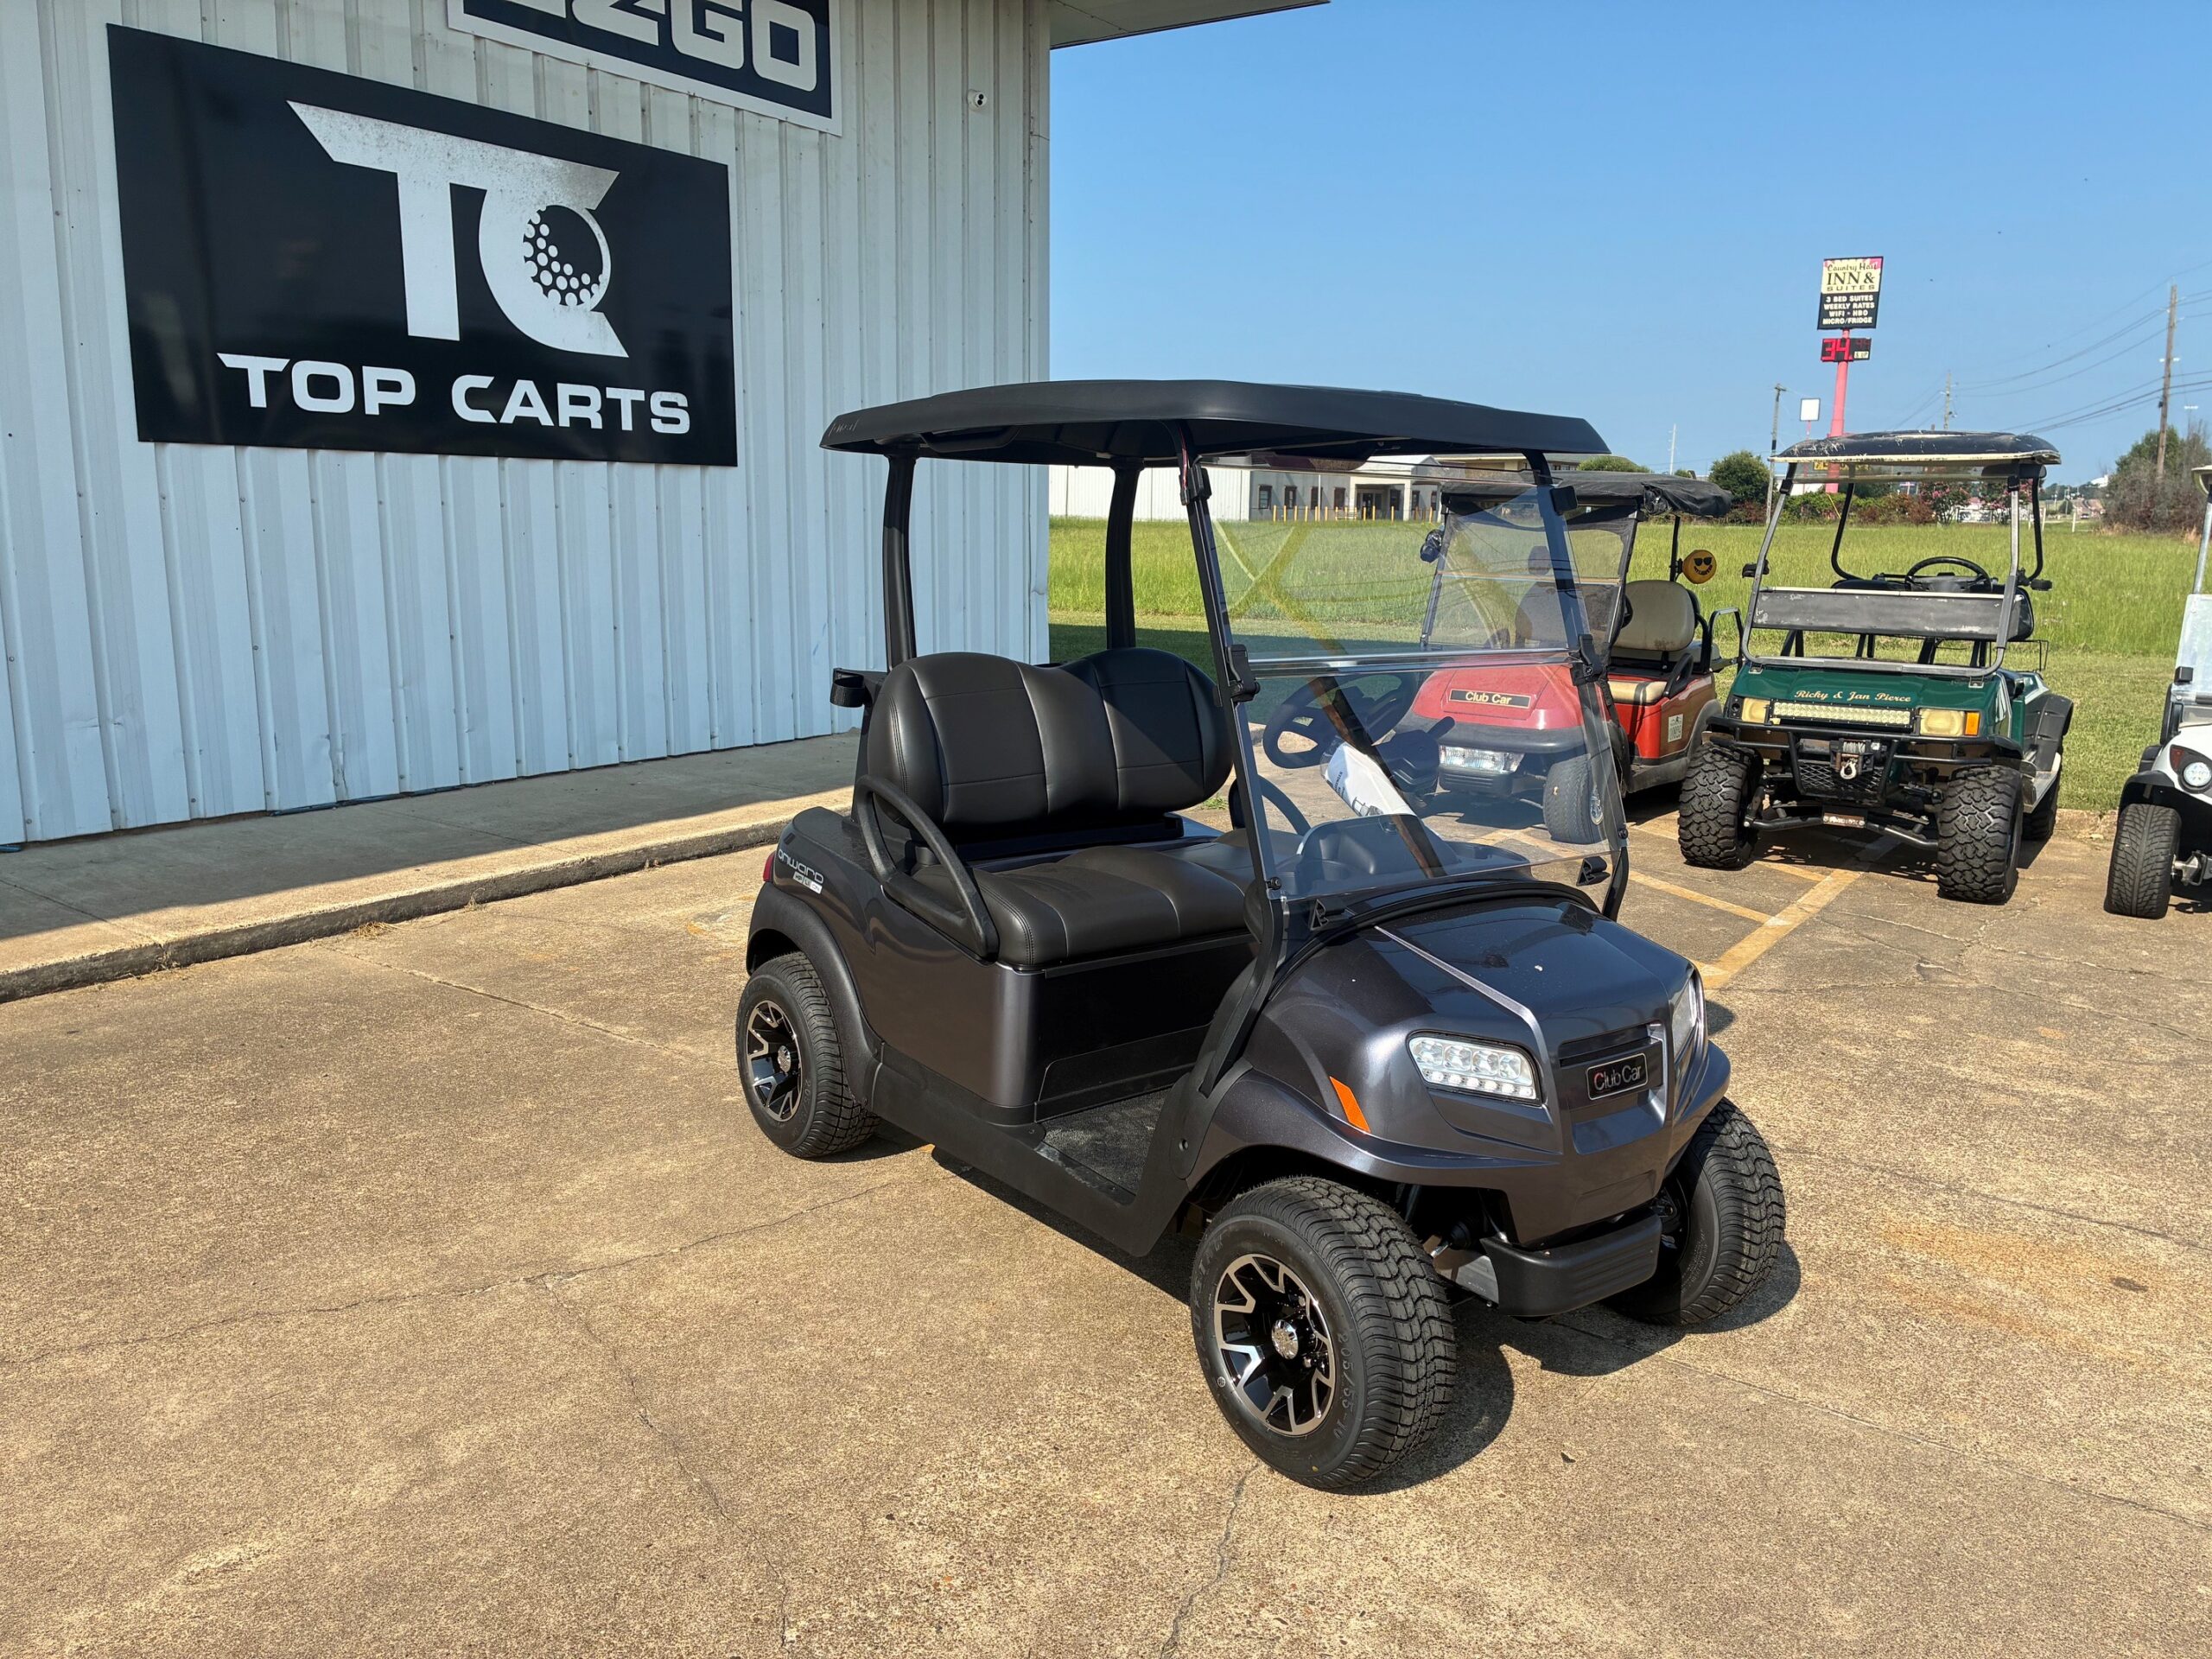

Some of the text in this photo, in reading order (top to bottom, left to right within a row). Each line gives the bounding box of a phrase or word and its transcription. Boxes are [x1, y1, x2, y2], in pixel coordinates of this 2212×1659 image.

[287, 101, 629, 358] TC
[1827, 271, 1875, 285] INN &
[217, 353, 690, 434] TOP CARTS
[1465, 691, 1512, 704] Club Car
[1794, 690, 1828, 700] Ricky
[1847, 691, 1870, 701] Jan
[1874, 692, 1911, 702] Pierce
[1593, 1065, 1642, 1090] Club Car
